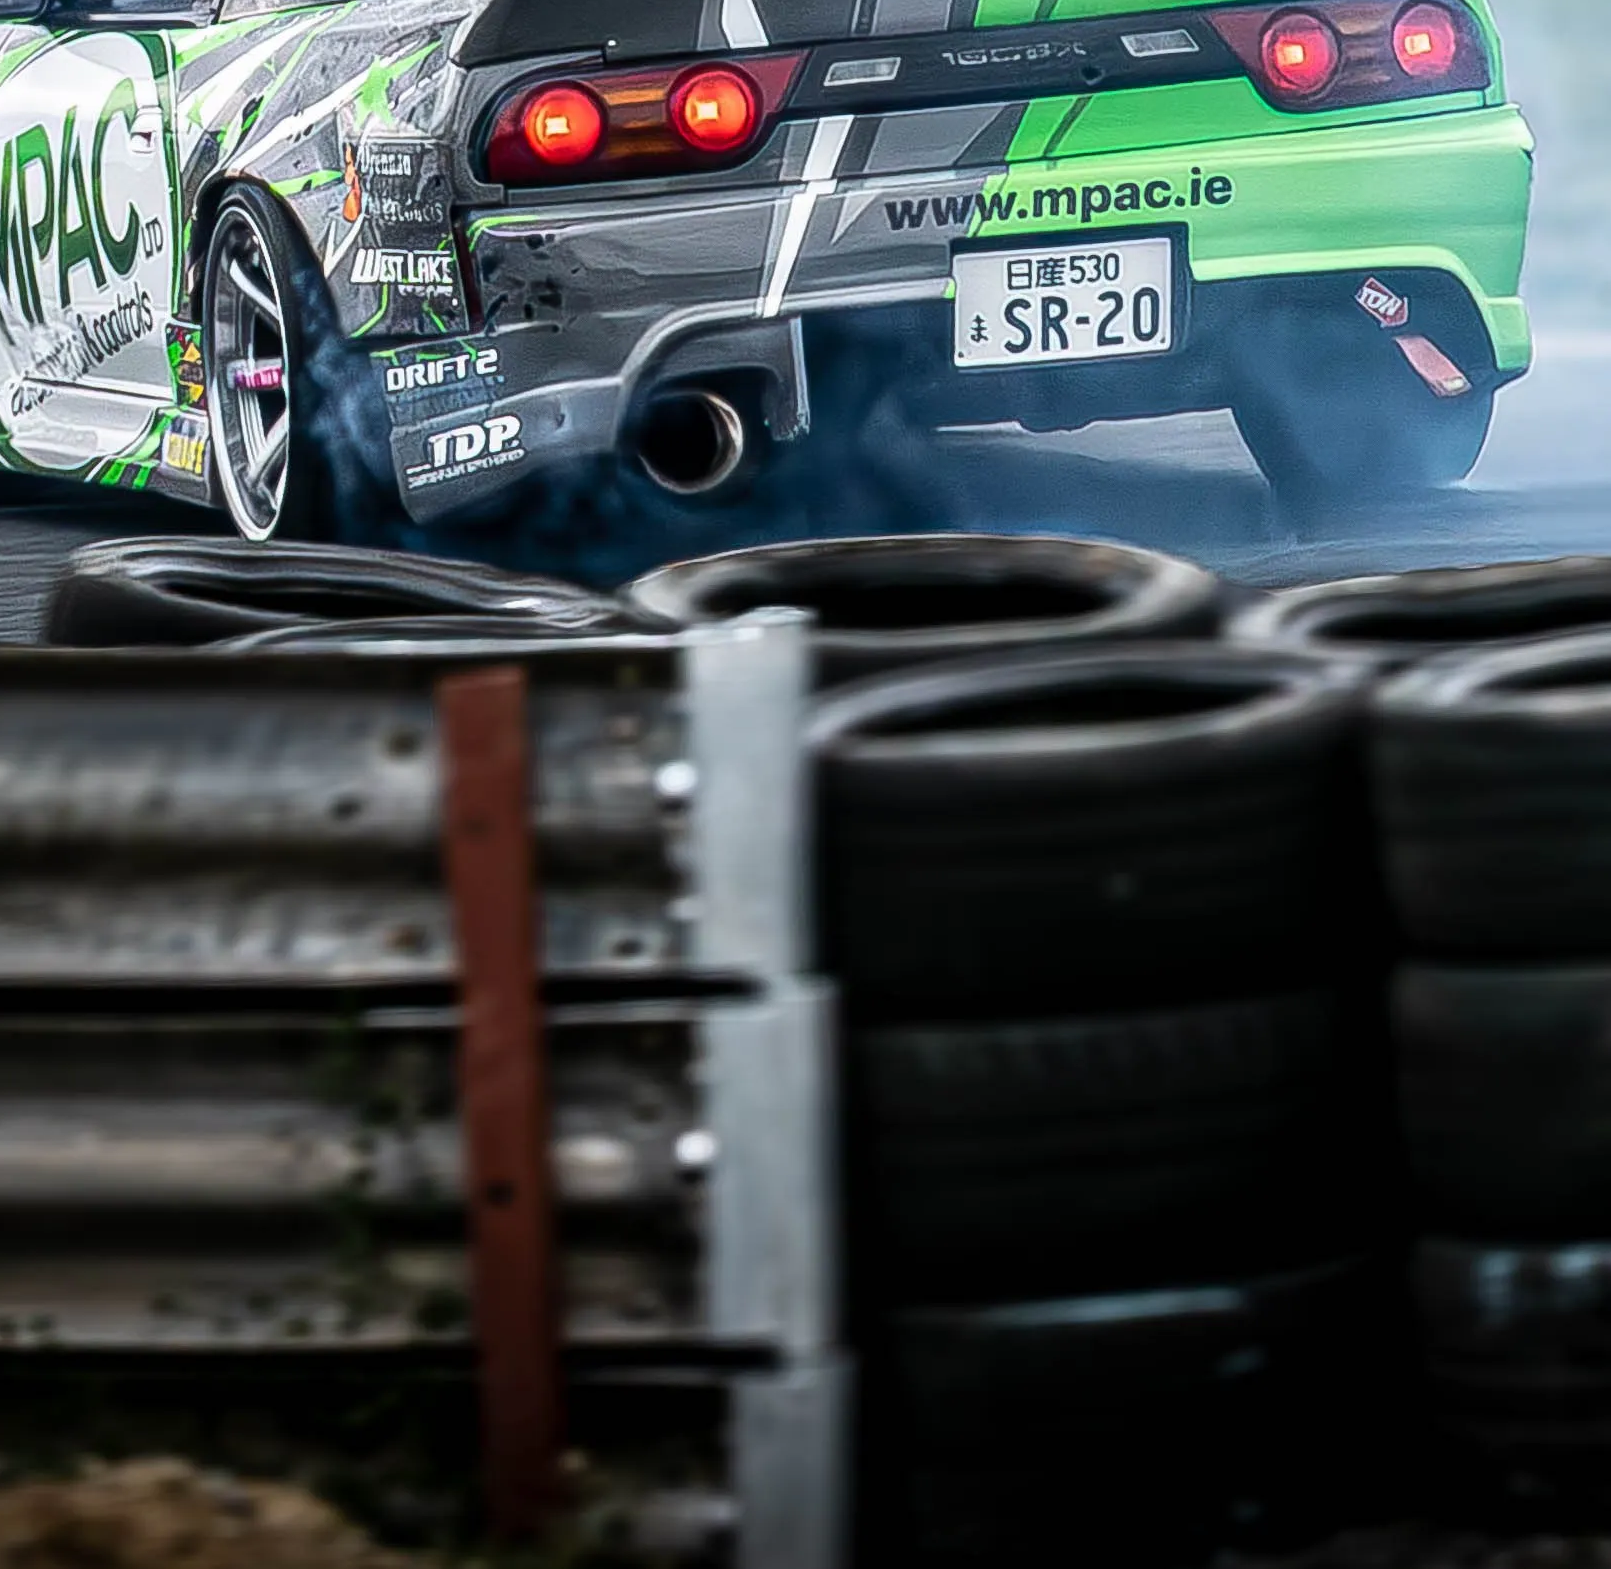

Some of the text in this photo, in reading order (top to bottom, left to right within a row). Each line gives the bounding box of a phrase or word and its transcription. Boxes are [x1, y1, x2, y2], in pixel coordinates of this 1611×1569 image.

[884, 166, 1233, 231] www.mpac.ie
[141, 216, 164, 261] LTD
[1003, 286, 1161, 354] SR-20
[386, 348, 499, 392] DRIFT 2
[427, 415, 521, 468] TDP
